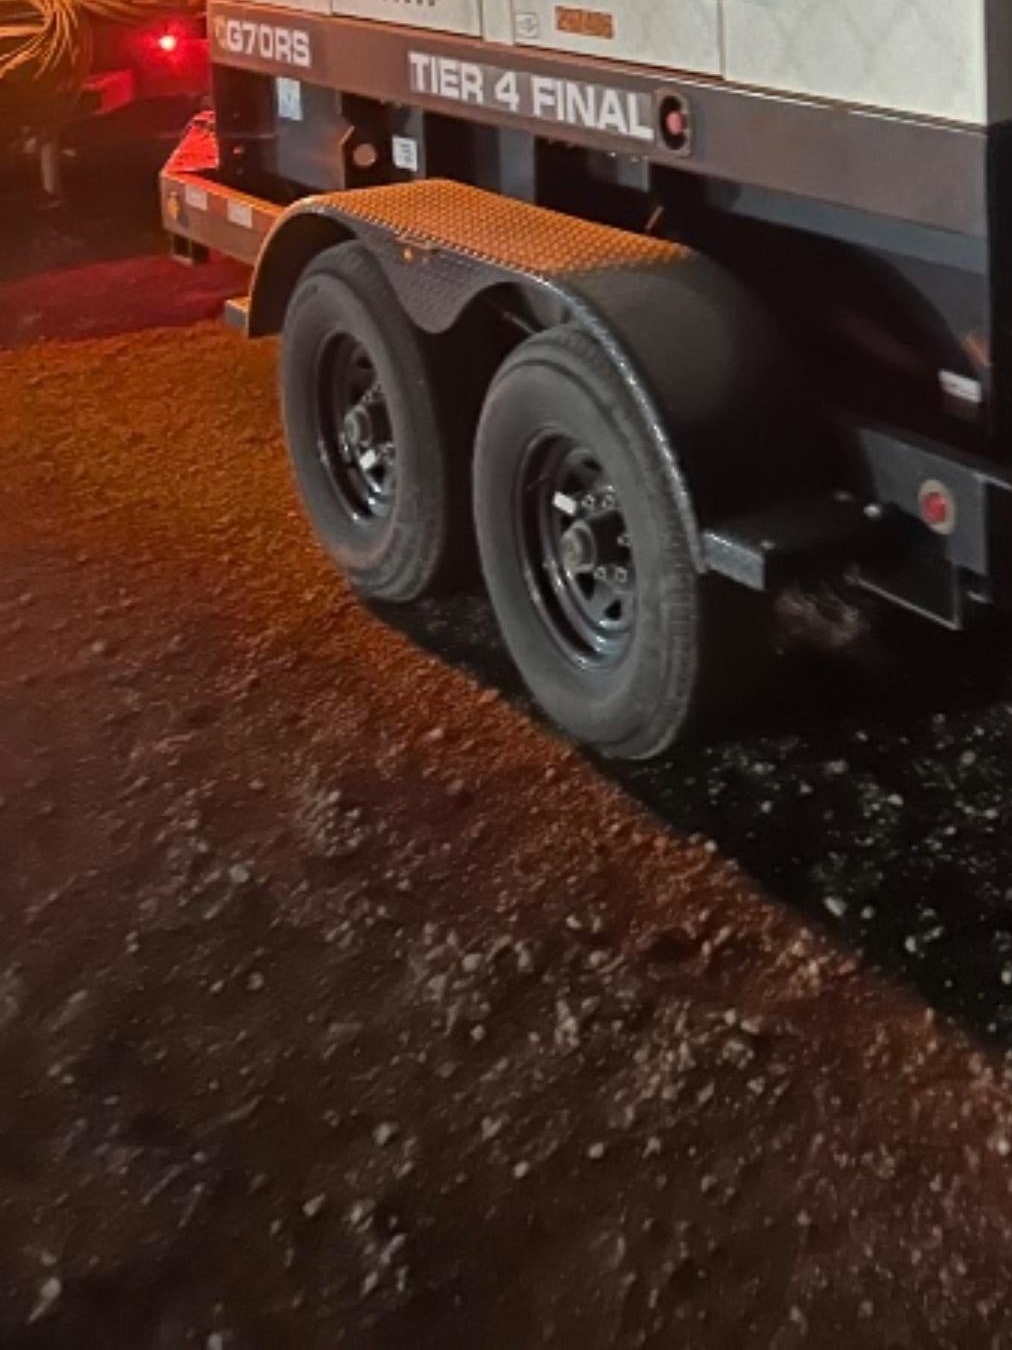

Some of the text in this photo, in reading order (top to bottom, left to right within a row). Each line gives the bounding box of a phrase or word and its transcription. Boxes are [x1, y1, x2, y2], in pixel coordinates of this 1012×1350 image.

[408, 51, 655, 140] TIER 4 FINAL
